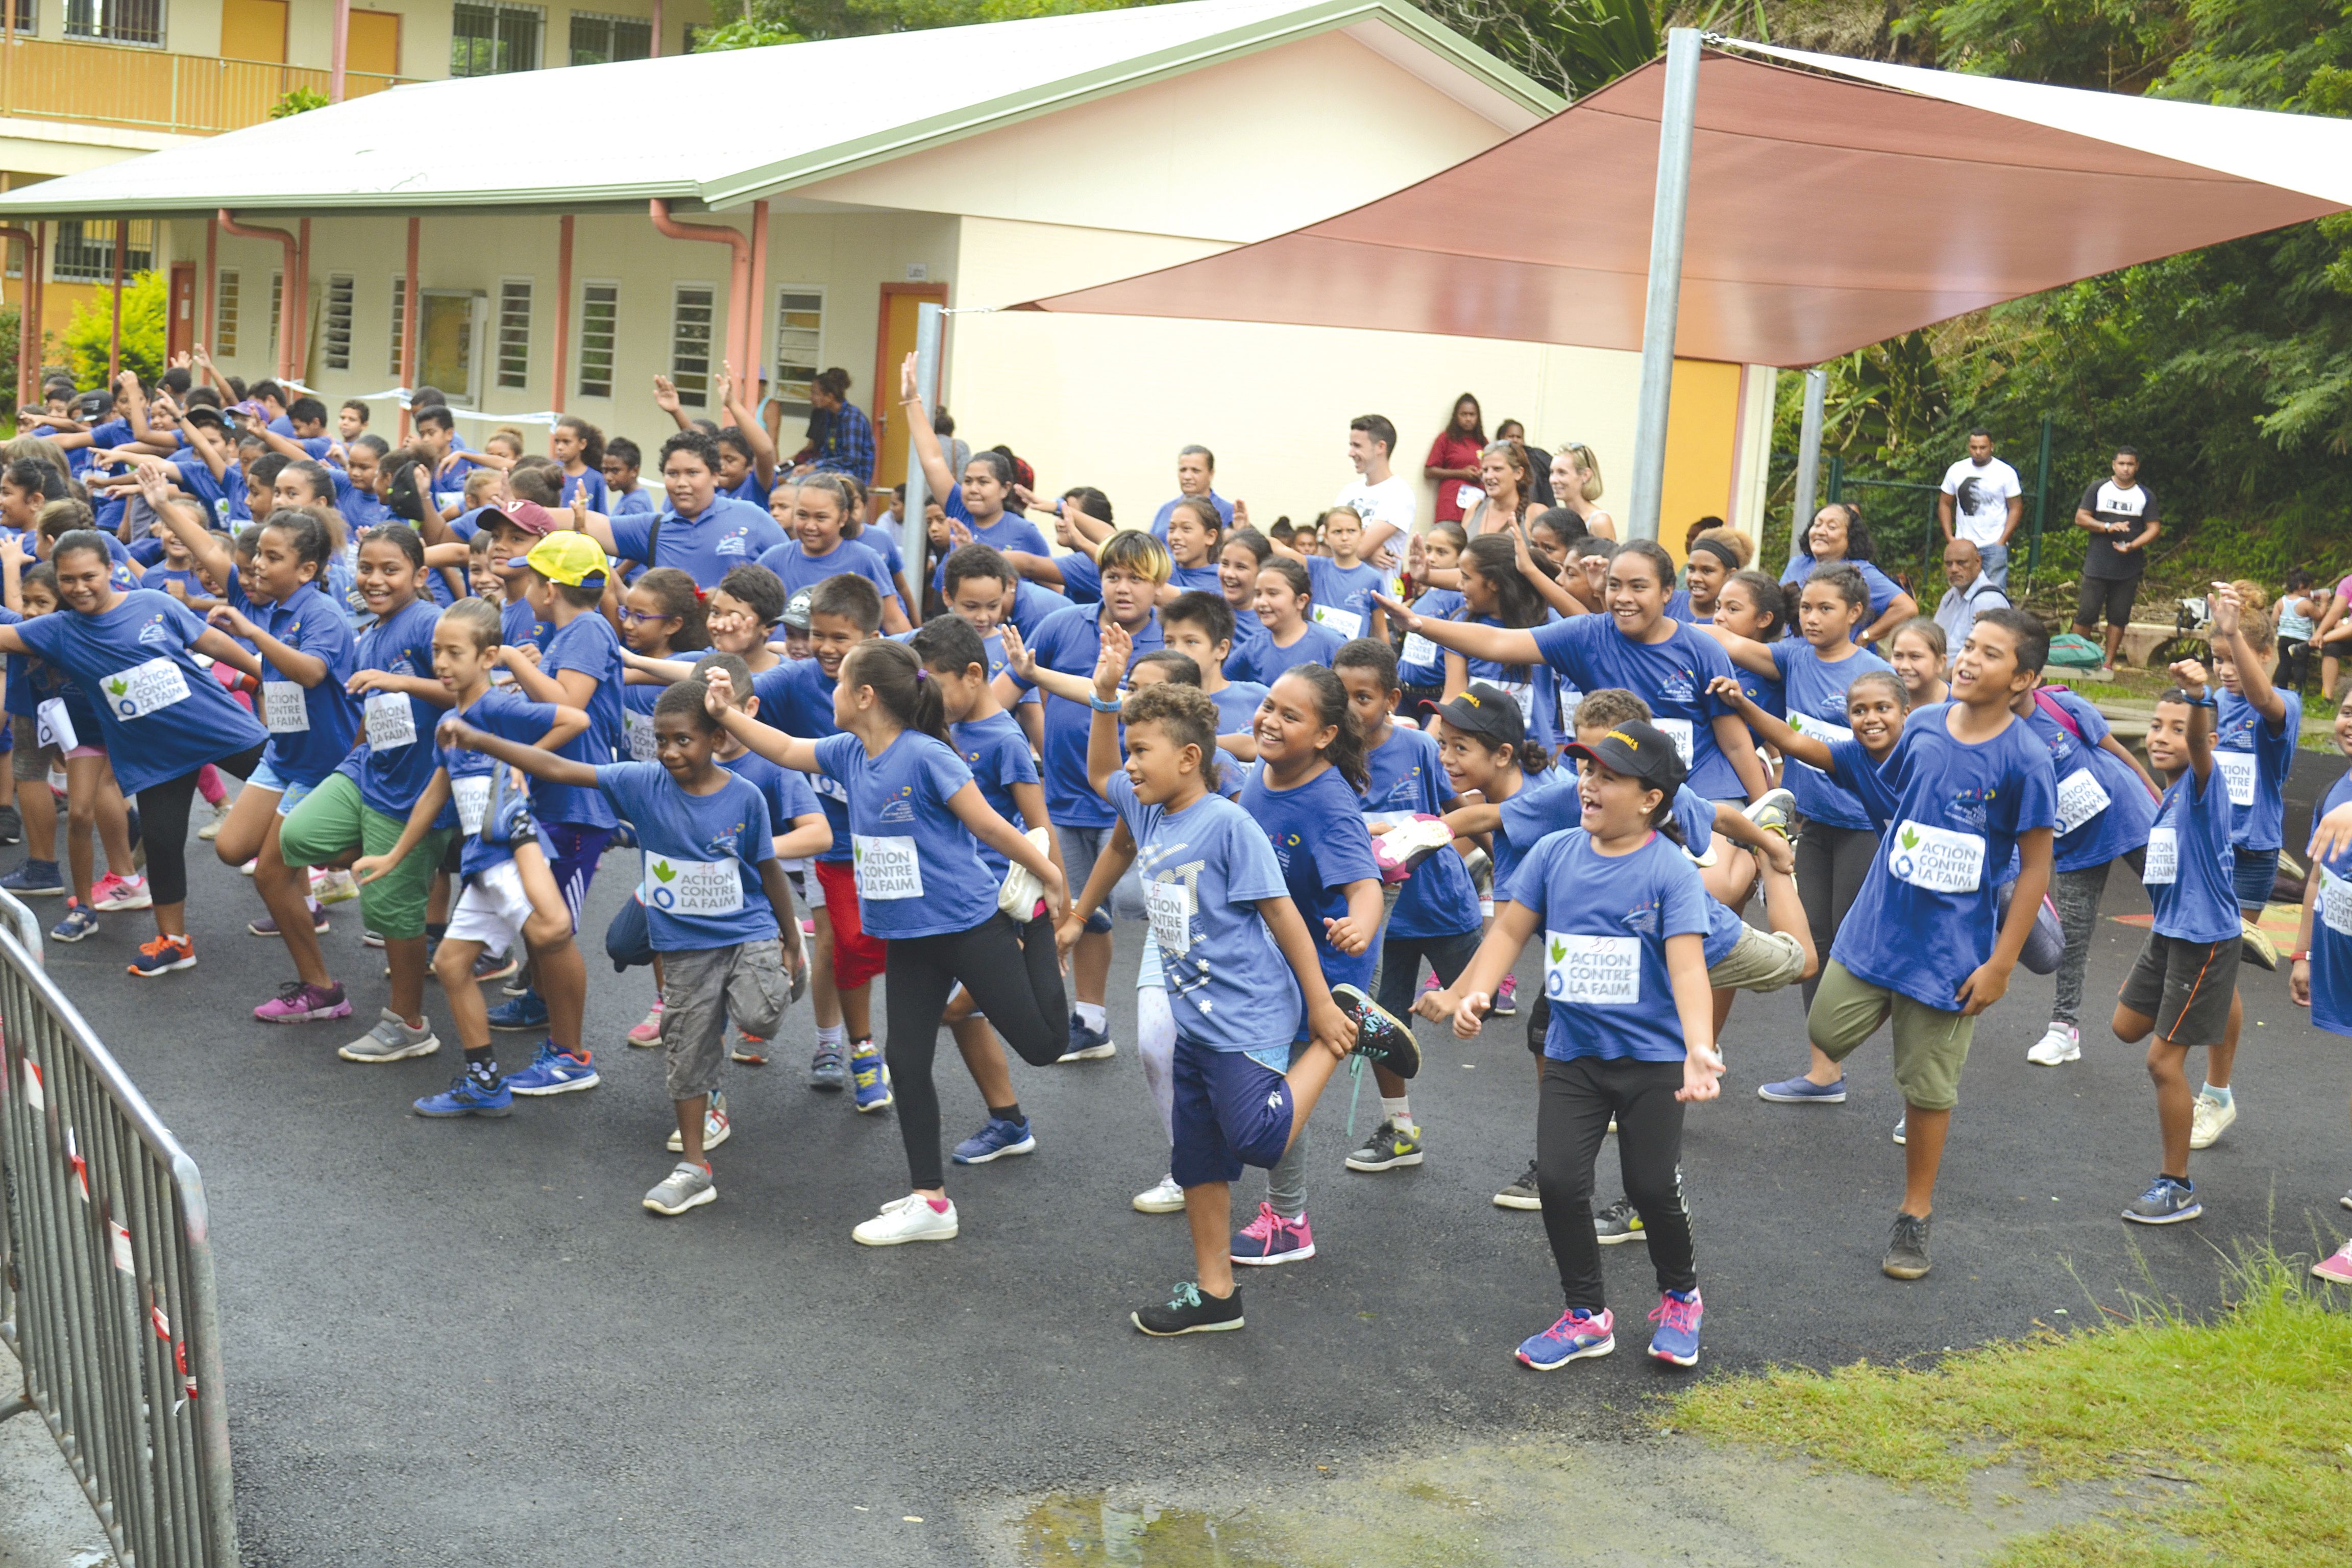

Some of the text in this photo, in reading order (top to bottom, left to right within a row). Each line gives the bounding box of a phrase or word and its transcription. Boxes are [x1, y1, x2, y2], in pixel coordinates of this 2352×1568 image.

[133, 667, 174, 689] ACTION
[136, 675, 179, 699] CONTRE
[140, 686, 183, 708] LA FAIM
[277, 715, 304, 725] FAIM
[2220, 765, 2250, 775] TION
[2226, 776, 2250, 787] NTRE
[2228, 788, 2248, 798] AIM
[2061, 787, 2097, 815] CONTRE
[864, 851, 910, 864] ACTION
[1922, 842, 1977, 862] ACTION
[864, 865, 913, 877] CONTRE
[1920, 855, 1975, 874] CONTRE
[681, 870, 734, 885] ACTION
[865, 877, 915, 891] LA FAIM
[1936, 871, 1972, 887] FAIM
[681, 884, 736, 896] CONTRE
[681, 896, 736, 908] LA FAIM
[2338, 915, 2352, 930] FAI
[1571, 952, 1632, 966] ACTION
[1570, 967, 1632, 981] CONTRE
[1570, 982, 1631, 996] LA FAIM
